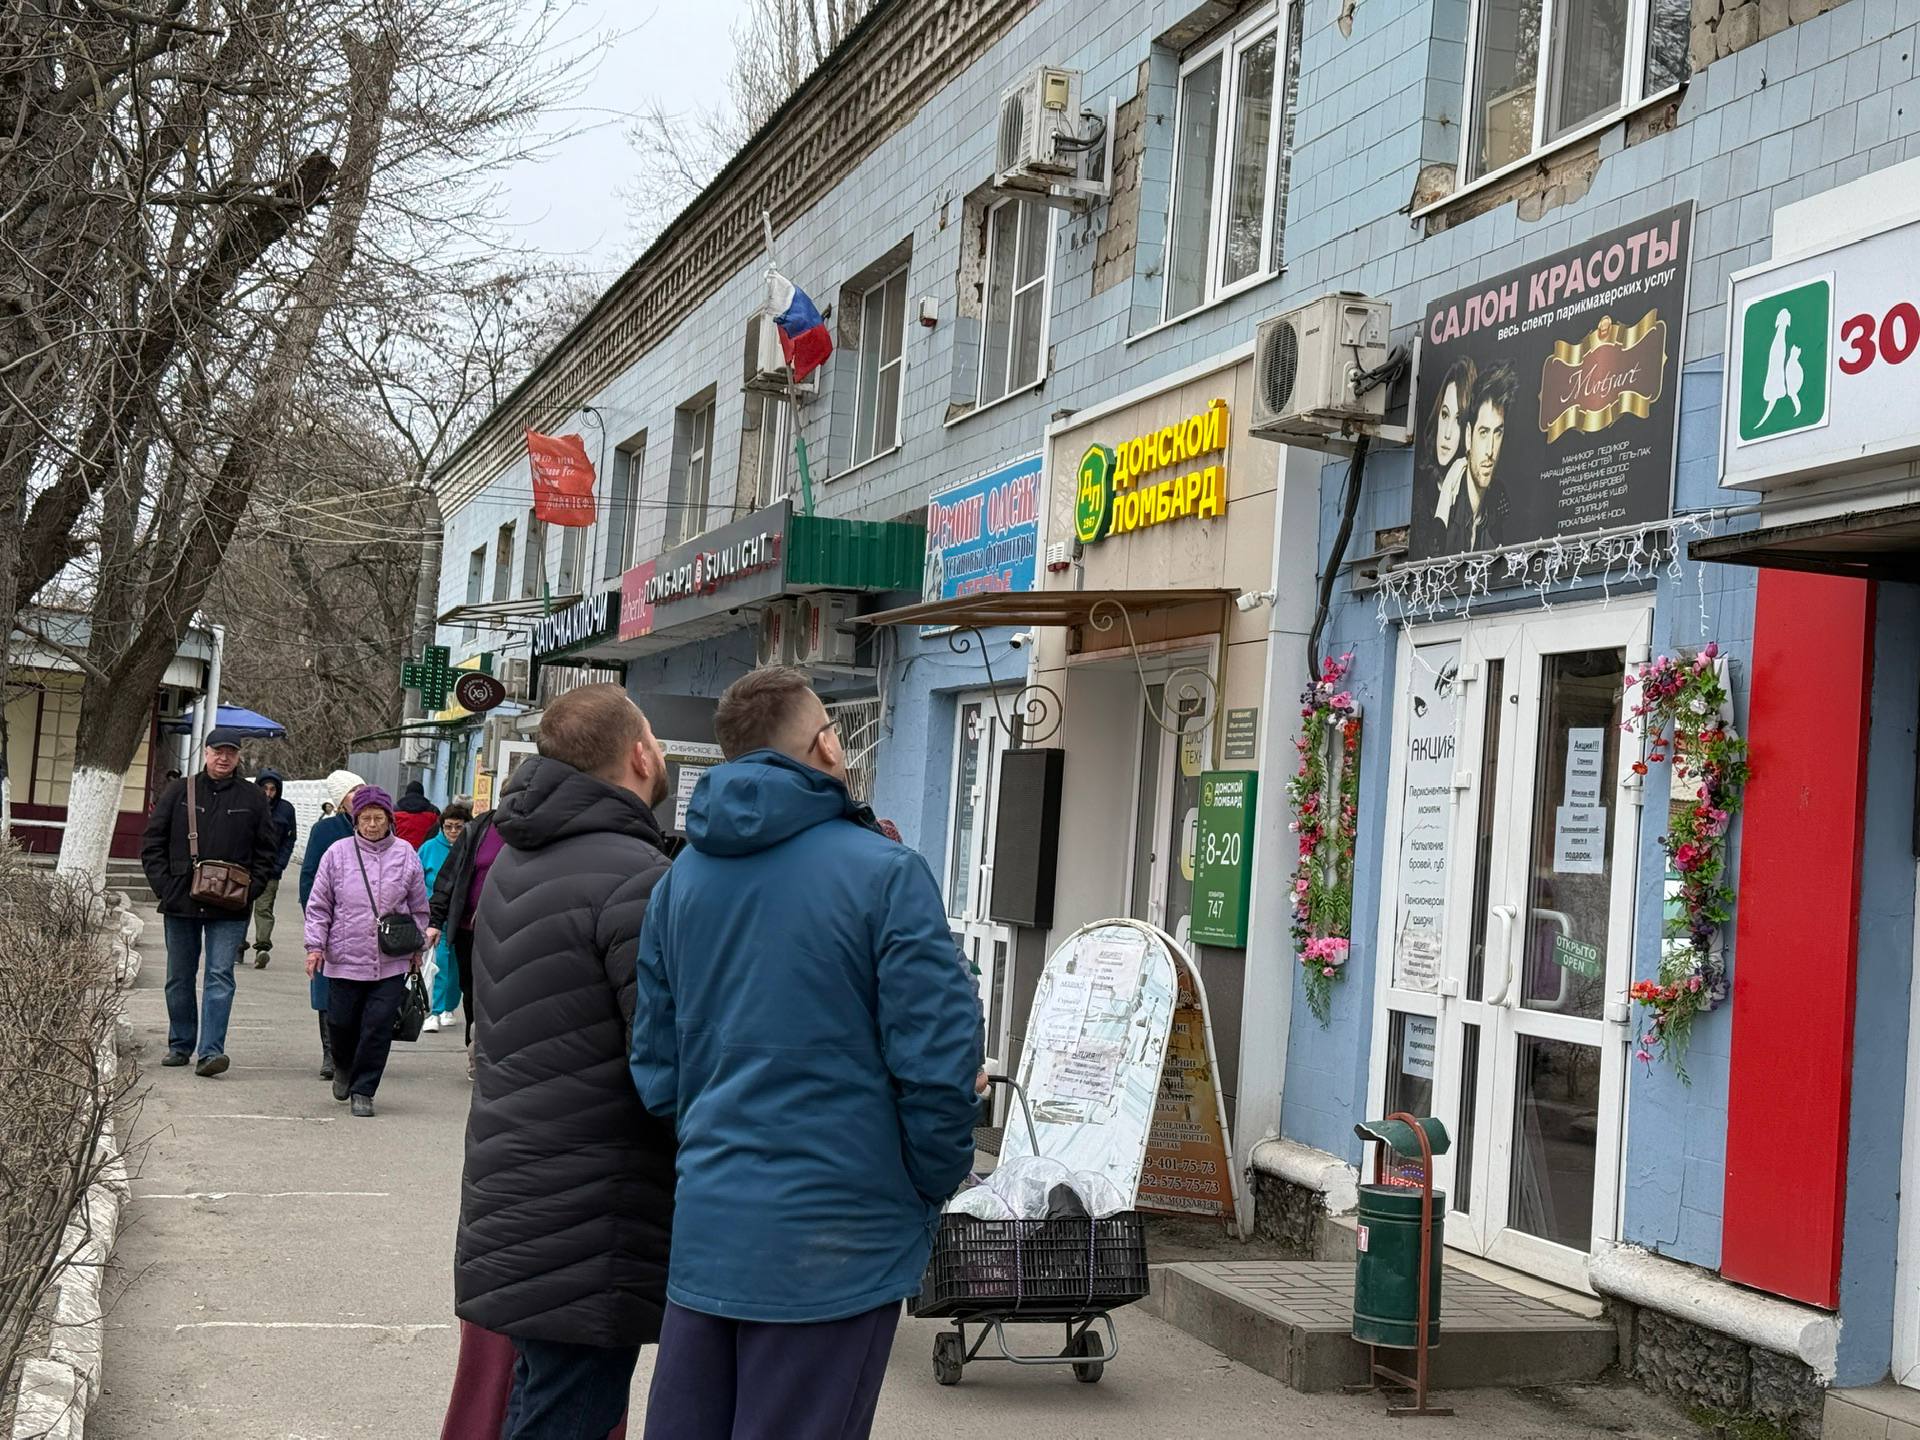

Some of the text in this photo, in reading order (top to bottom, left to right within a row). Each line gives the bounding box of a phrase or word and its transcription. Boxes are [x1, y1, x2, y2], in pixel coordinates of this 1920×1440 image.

[1430, 219, 1681, 345] САЛОН КРАСОТЫ
[1497, 267, 1676, 341] весь спектр парикмахерских услуг
[1560, 361, 1642, 403] Motsart
[1112, 399, 1225, 491] ДОНСКОЙ
[1561, 441, 1630, 464] МАНИКЮР ПЕДИКЮР
[1109, 466, 1224, 534] ЛОМБАРД
[706, 532, 767, 582] SUNLIGHT
[645, 563, 692, 603] ЛОМБАРД
[534, 591, 608, 656] ЗАТОЧКА КЛЮЧИ
[1411, 735, 1455, 763] АКЦИЯ
[1213, 796, 1242, 808] ЛОМБАРД
[1214, 780, 1243, 795] ДОНСКОЙ
[1206, 832, 1241, 866] 8-20
[1208, 900, 1224, 918] 747
[1556, 935, 1597, 960] ОТКРЫТО
[1563, 954, 1585, 973] OPEN
